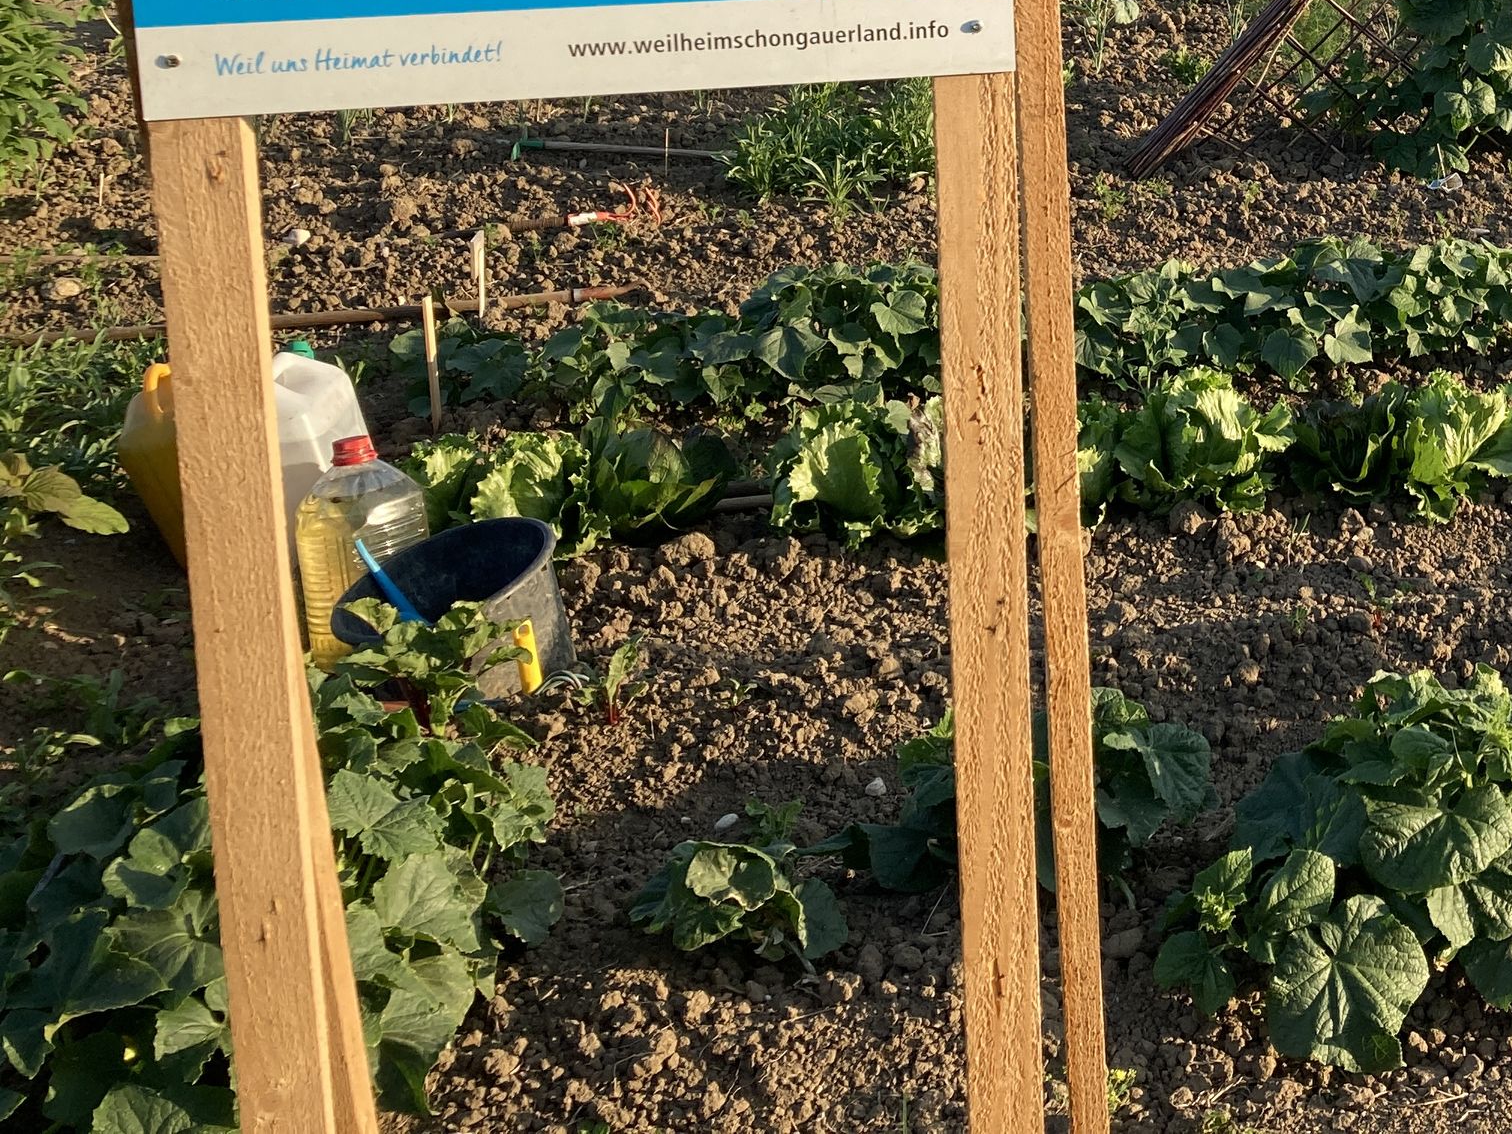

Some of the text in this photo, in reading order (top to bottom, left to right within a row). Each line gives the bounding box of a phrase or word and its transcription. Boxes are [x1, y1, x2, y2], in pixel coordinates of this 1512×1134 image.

[567, 20, 950, 58] www.weilheimschongauerland.info
[214, 41, 503, 75] Weil uns Heimat verbindet!
